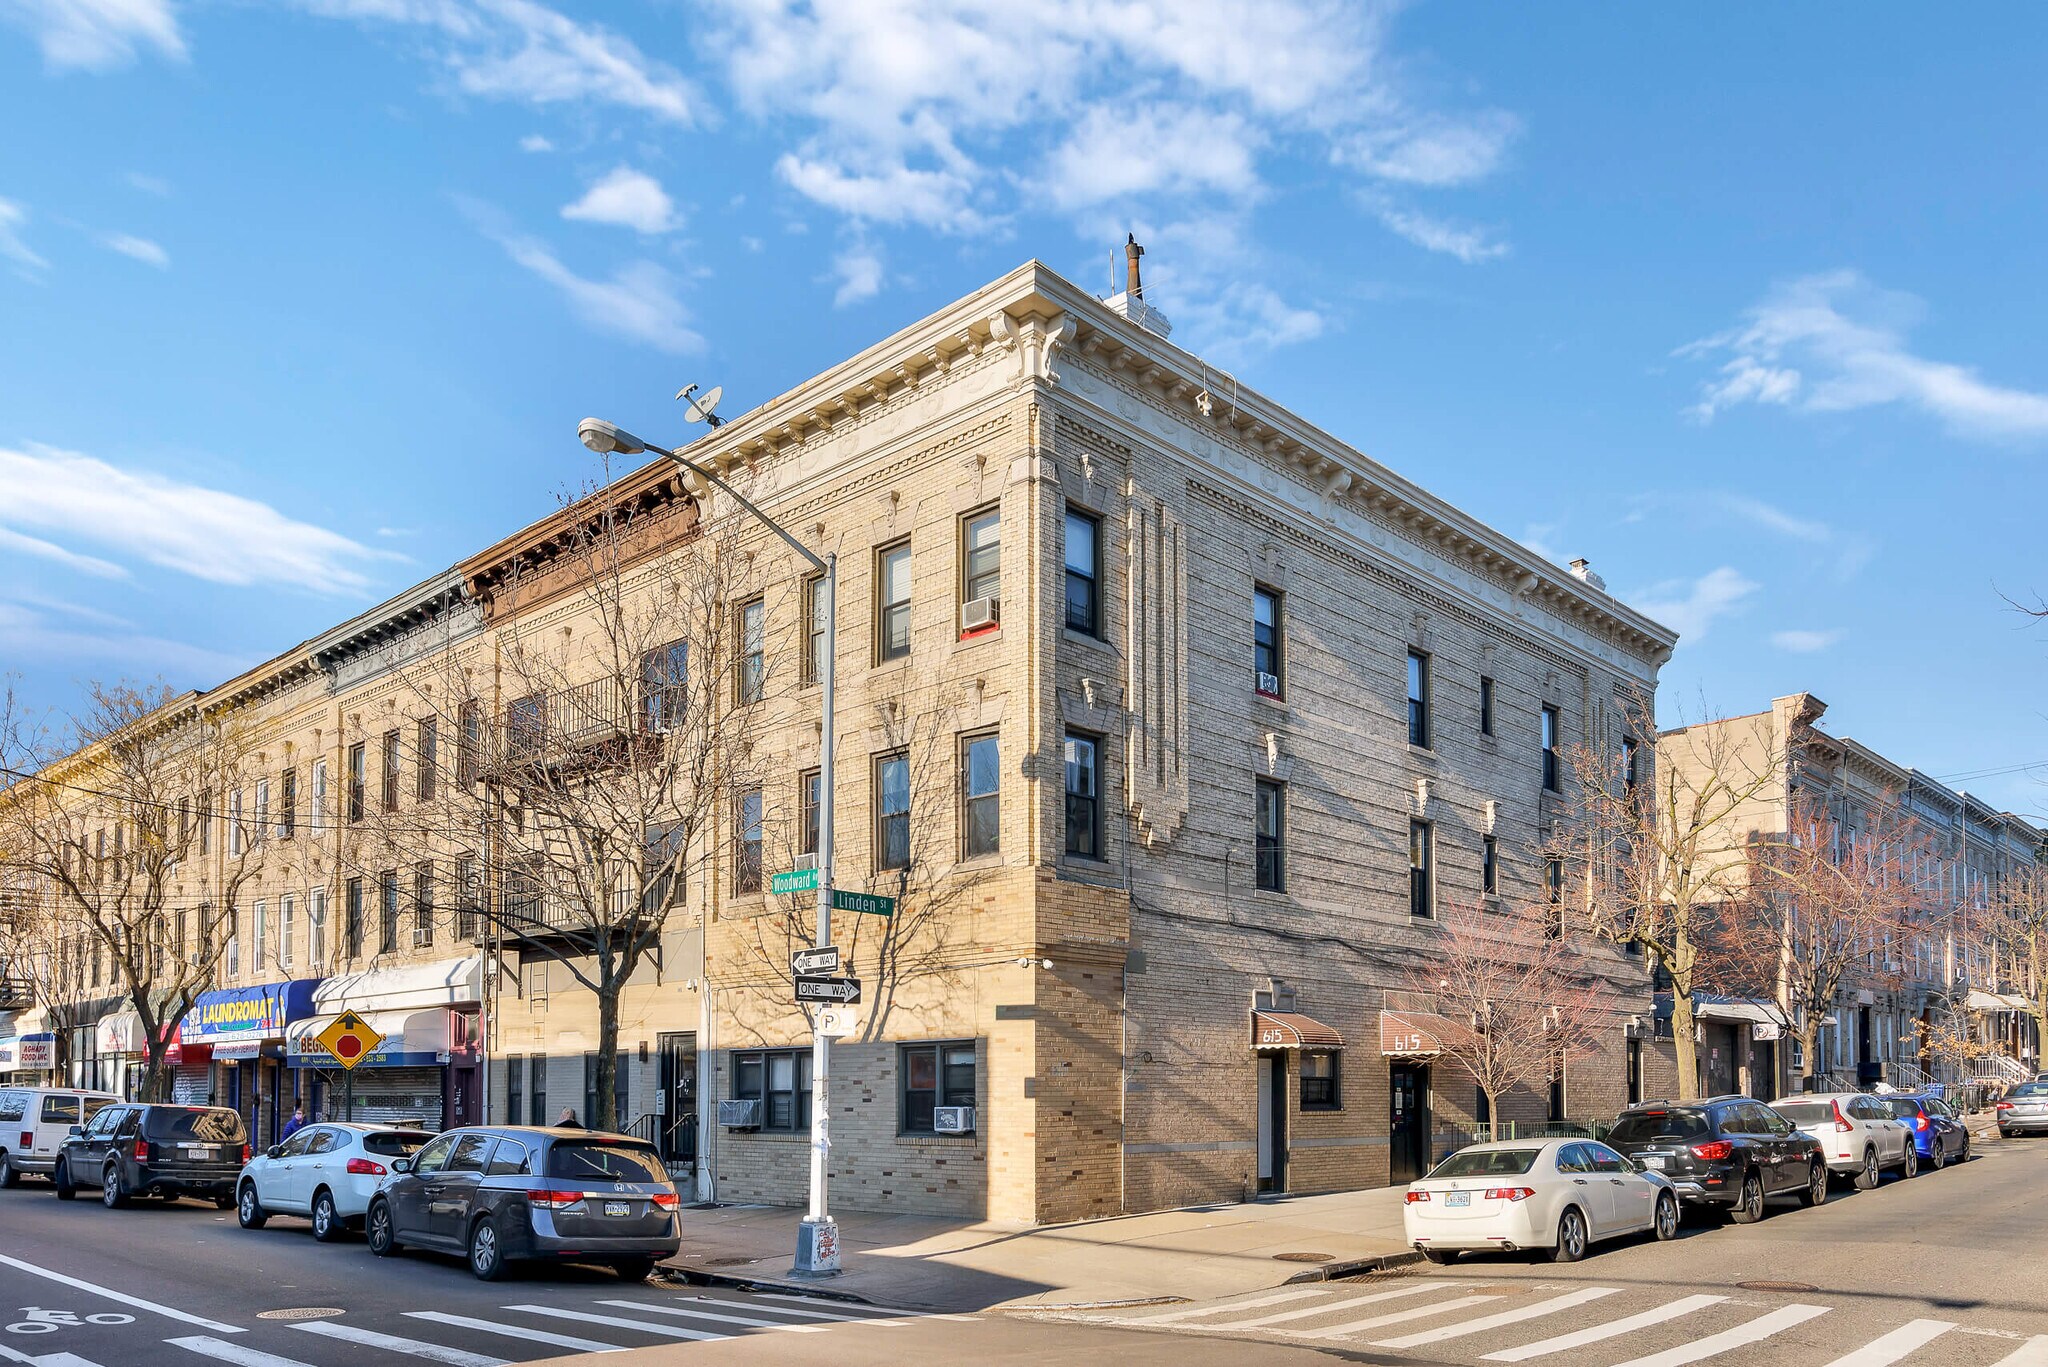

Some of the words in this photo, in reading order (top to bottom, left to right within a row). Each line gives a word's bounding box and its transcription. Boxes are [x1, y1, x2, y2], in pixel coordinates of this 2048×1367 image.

[774, 873, 810, 891] Woodward
[839, 893, 876, 912] Linden
[880, 900, 887, 909] St
[798, 957, 812, 968] ONE
[819, 954, 835, 966] WAY
[801, 984, 821, 995] ONE
[832, 985, 853, 996] WAY
[202, 997, 274, 1025] LAUNDROMAT
[1262, 1029, 1283, 1043] 615
[1395, 1034, 1421, 1051] 615
[21, 1053, 36, 1061] FOOD
[38, 1053, 47, 1061] INC
